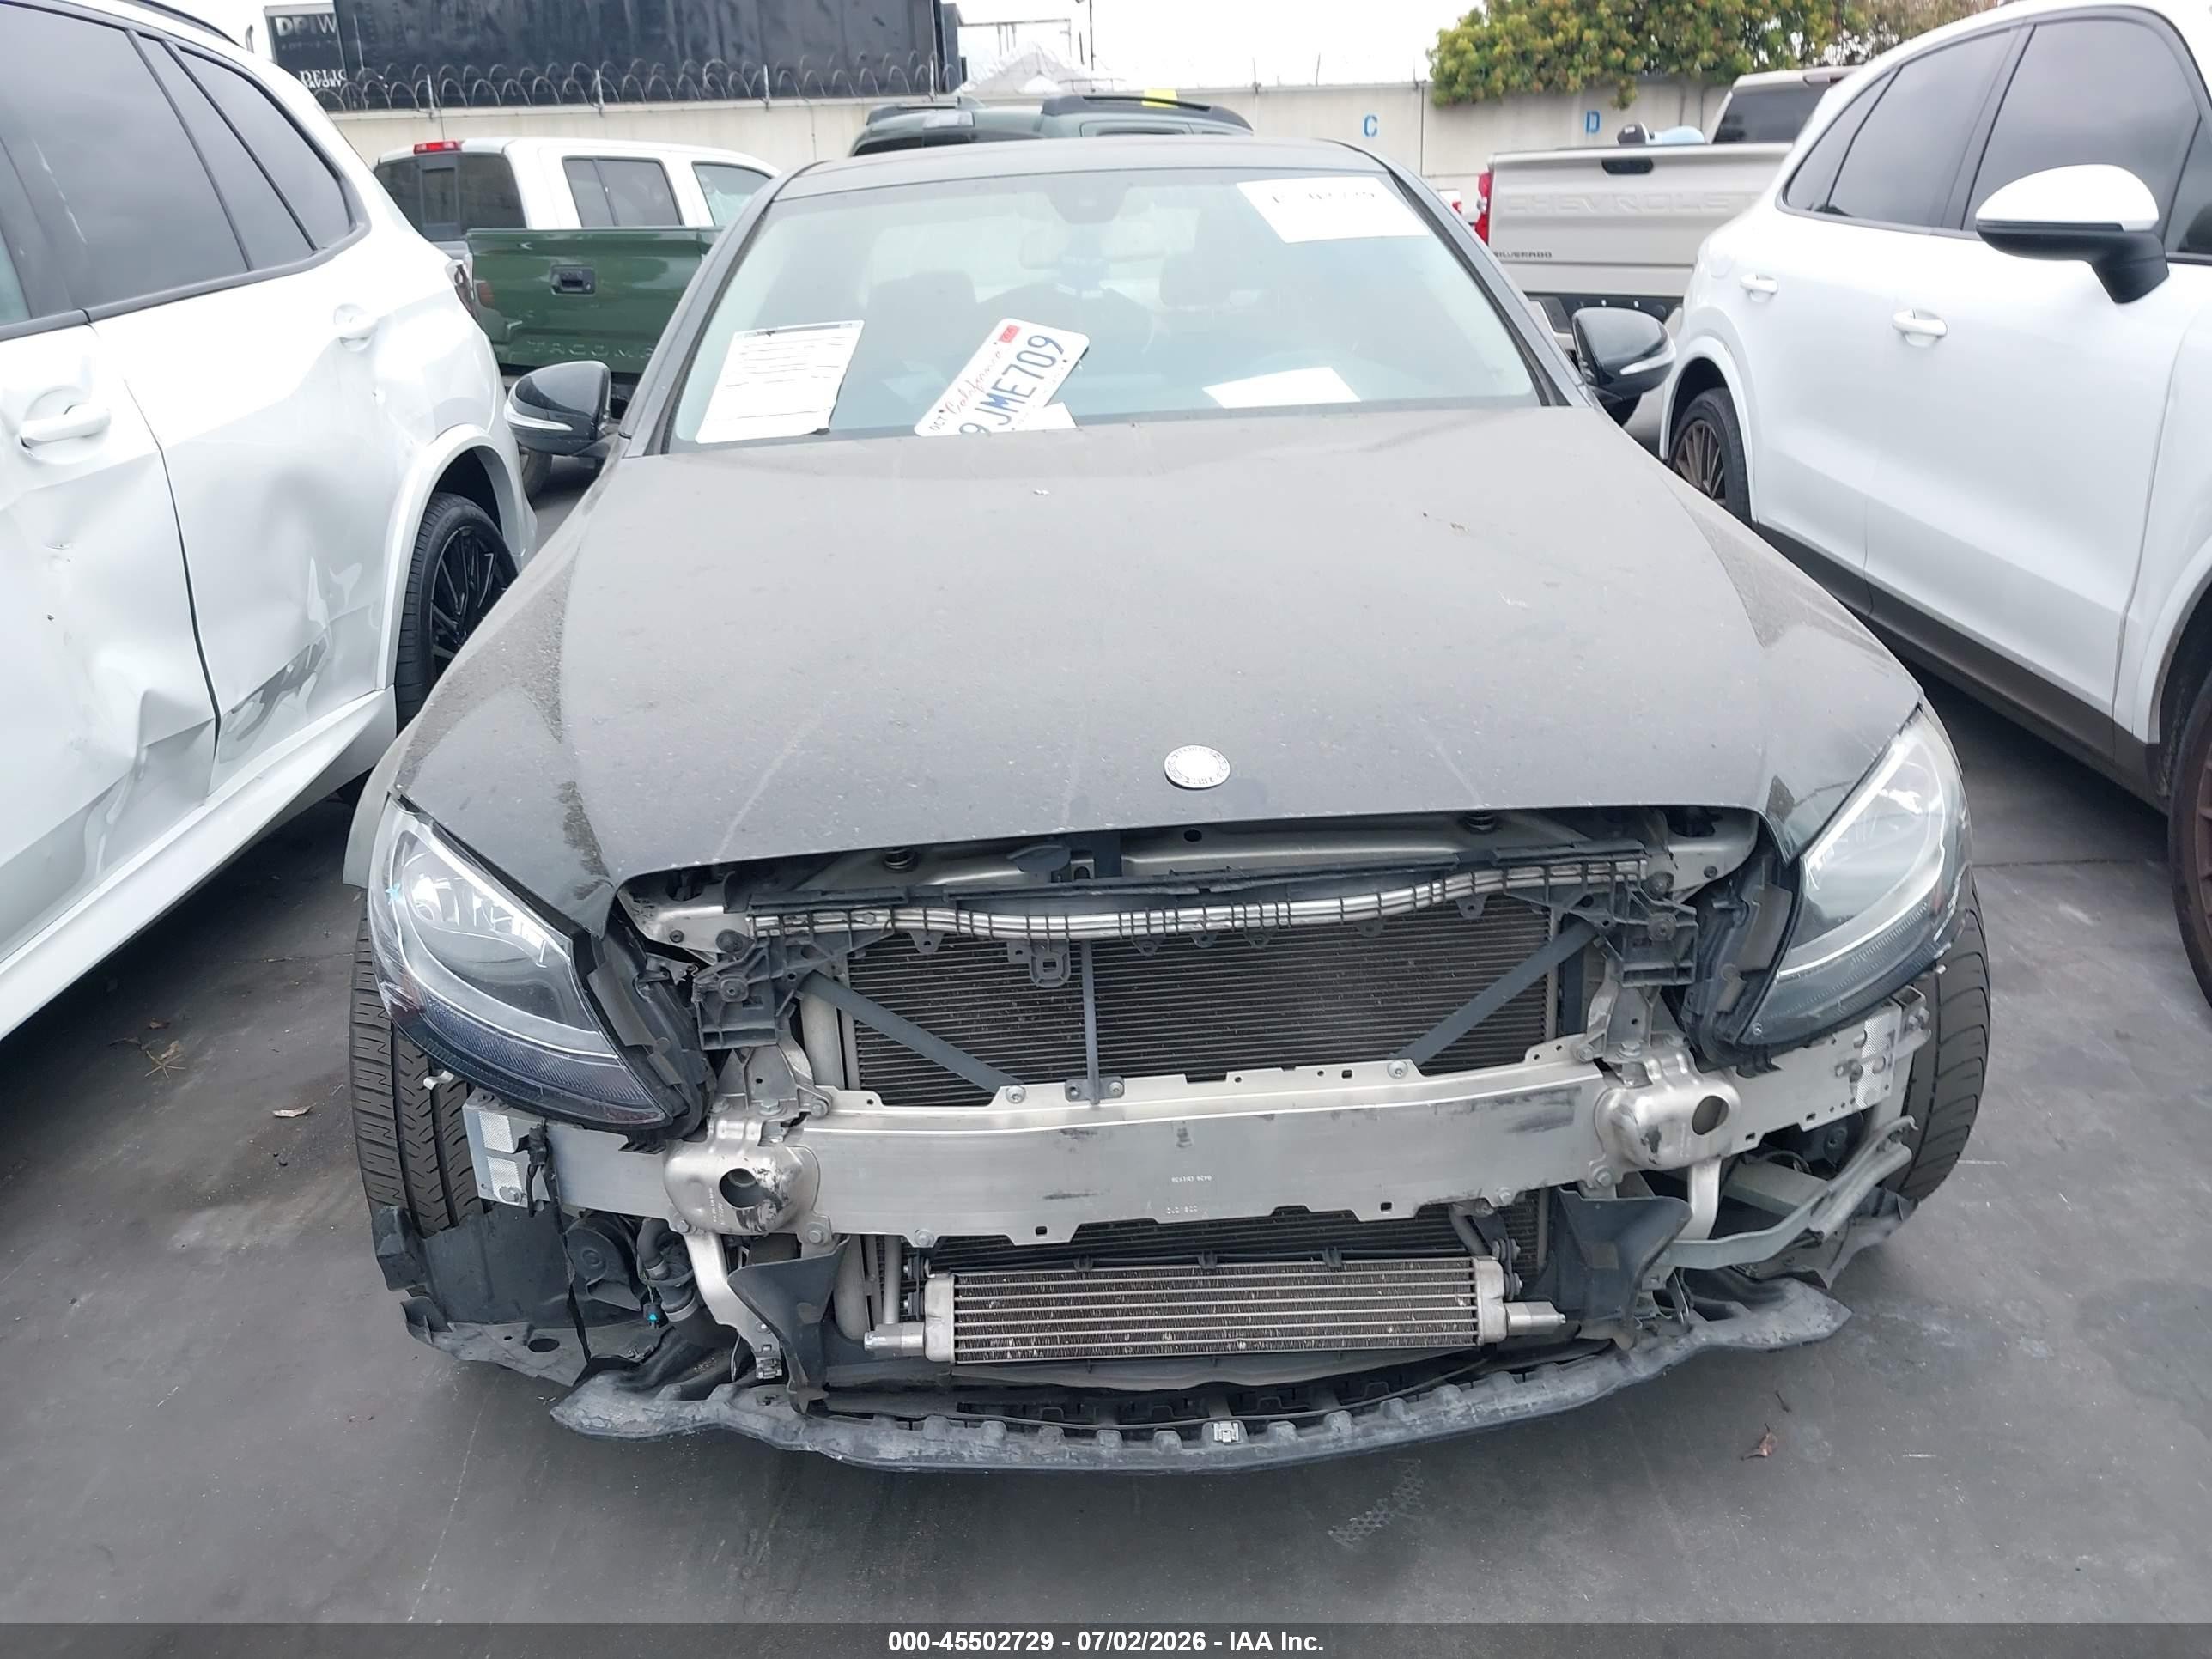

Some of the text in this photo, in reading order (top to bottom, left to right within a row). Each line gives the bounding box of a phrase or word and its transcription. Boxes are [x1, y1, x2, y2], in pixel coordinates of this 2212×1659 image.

[1364, 114, 1378, 137] C
[1586, 111, 1601, 133] D
[944, 350, 1003, 414] California
